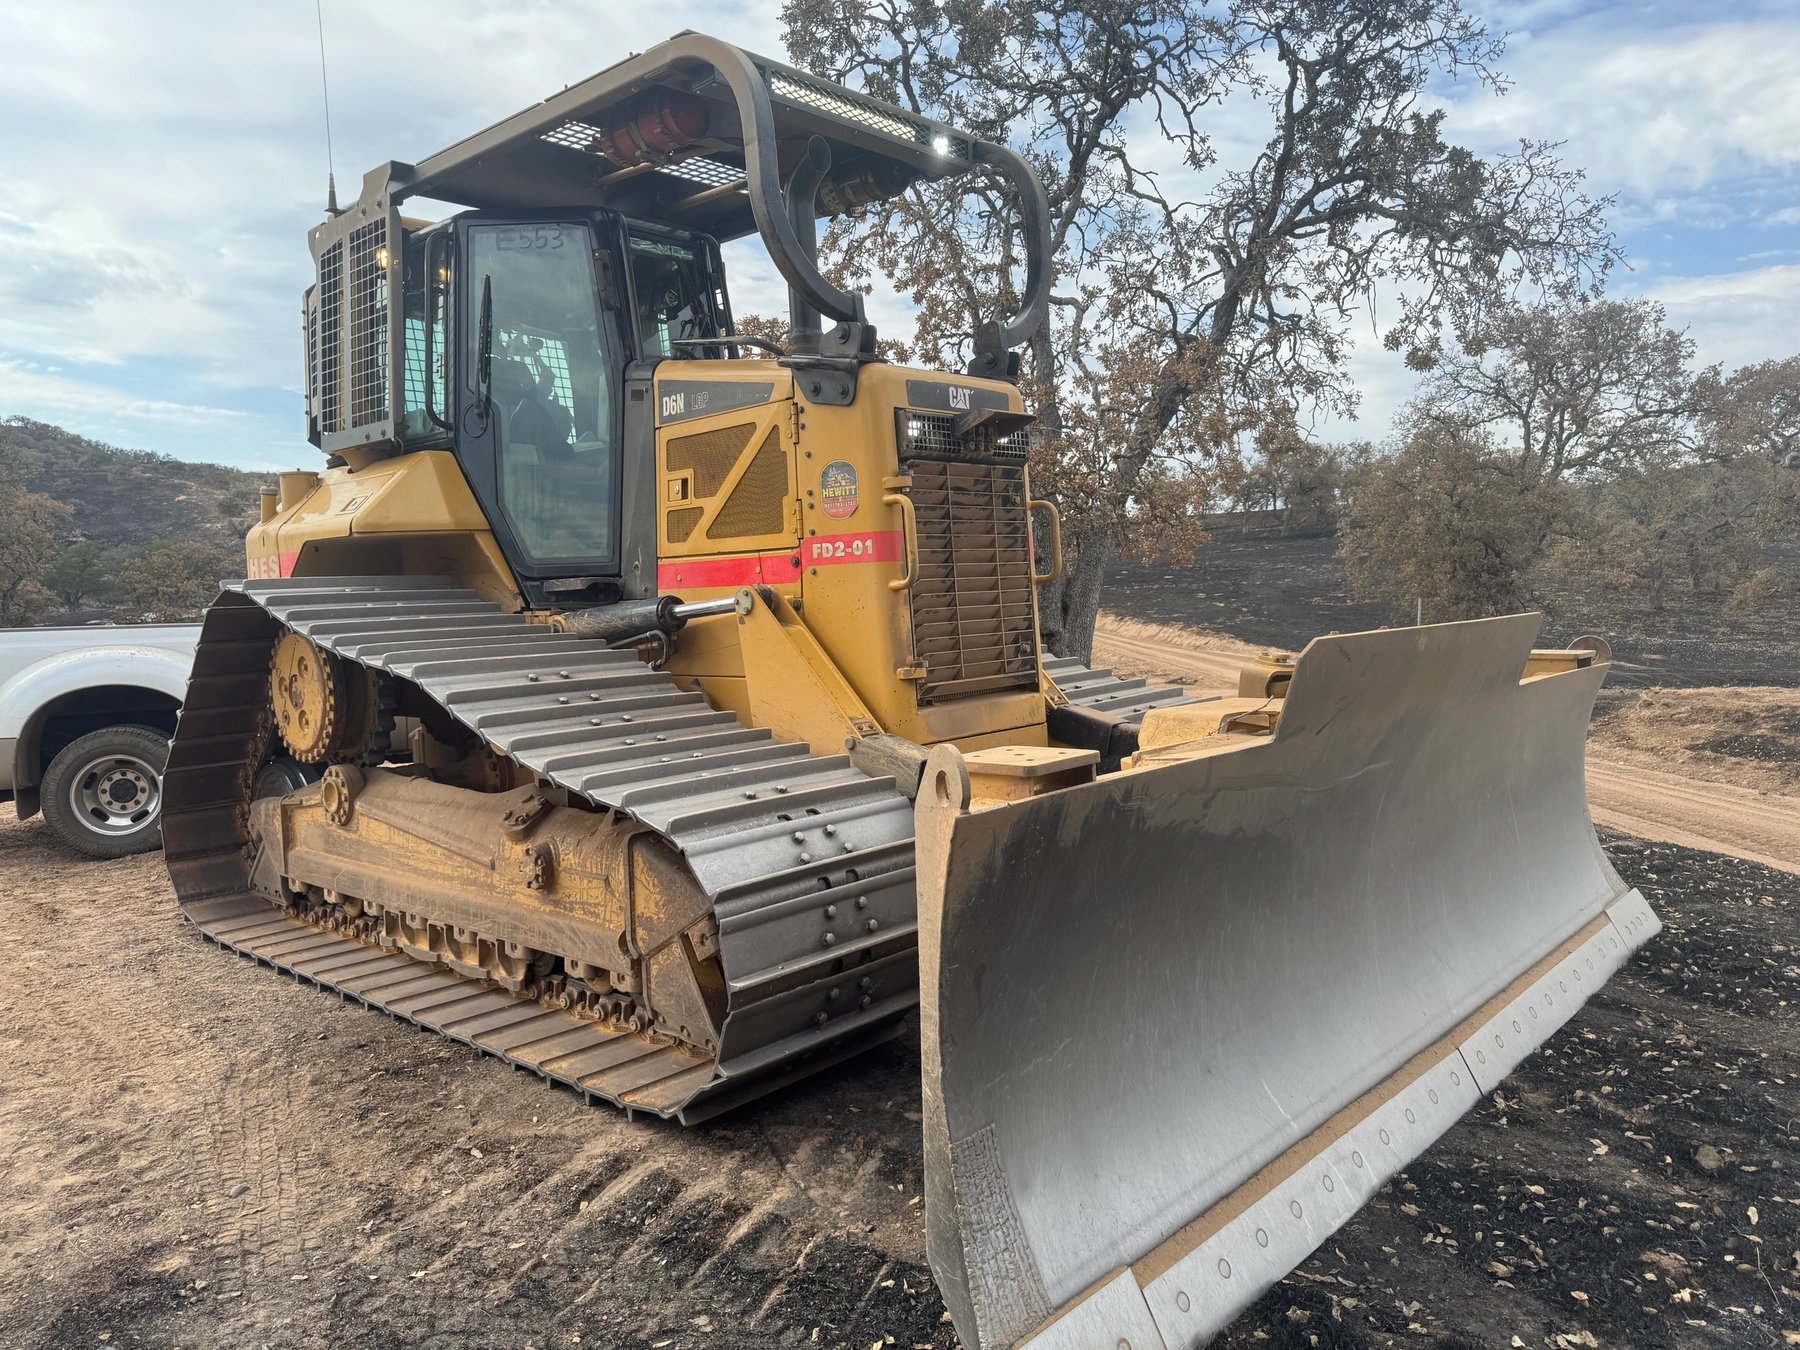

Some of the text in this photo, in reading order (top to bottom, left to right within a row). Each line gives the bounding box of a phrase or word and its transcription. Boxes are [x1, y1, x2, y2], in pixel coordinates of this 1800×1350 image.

[496, 226, 564, 251] E553
[662, 391, 709, 417] D6N LGP
[948, 386, 971, 410] CAT
[822, 485, 856, 498] HEWITT
[812, 539, 873, 559] FD2-01
